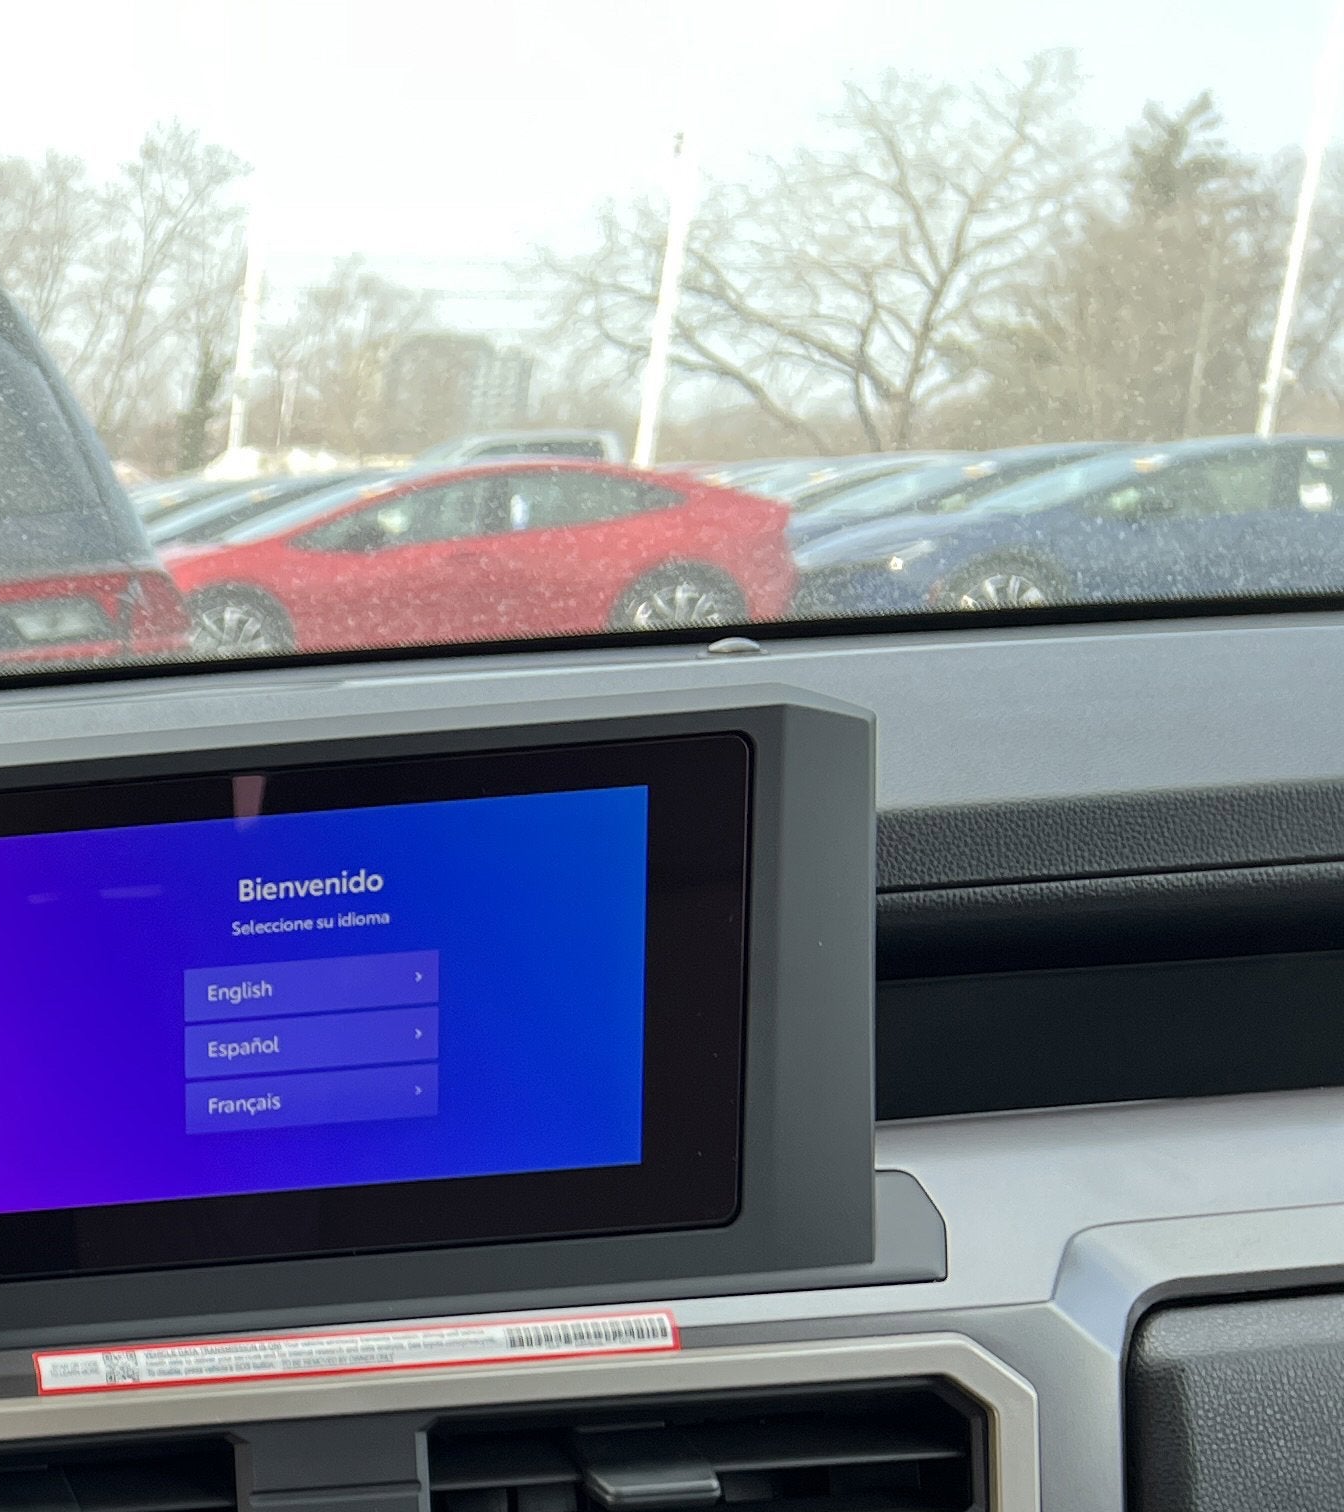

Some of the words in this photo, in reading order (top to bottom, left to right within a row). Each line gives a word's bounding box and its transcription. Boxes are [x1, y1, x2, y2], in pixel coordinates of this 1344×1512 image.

[237, 868, 384, 905] Bienvenido
[231, 916, 313, 938] Seleccione
[315, 915, 334, 931] su
[337, 910, 391, 929] idioma
[206, 978, 274, 1006] English
[206, 1034, 280, 1064] Español
[207, 1089, 282, 1118] Français
